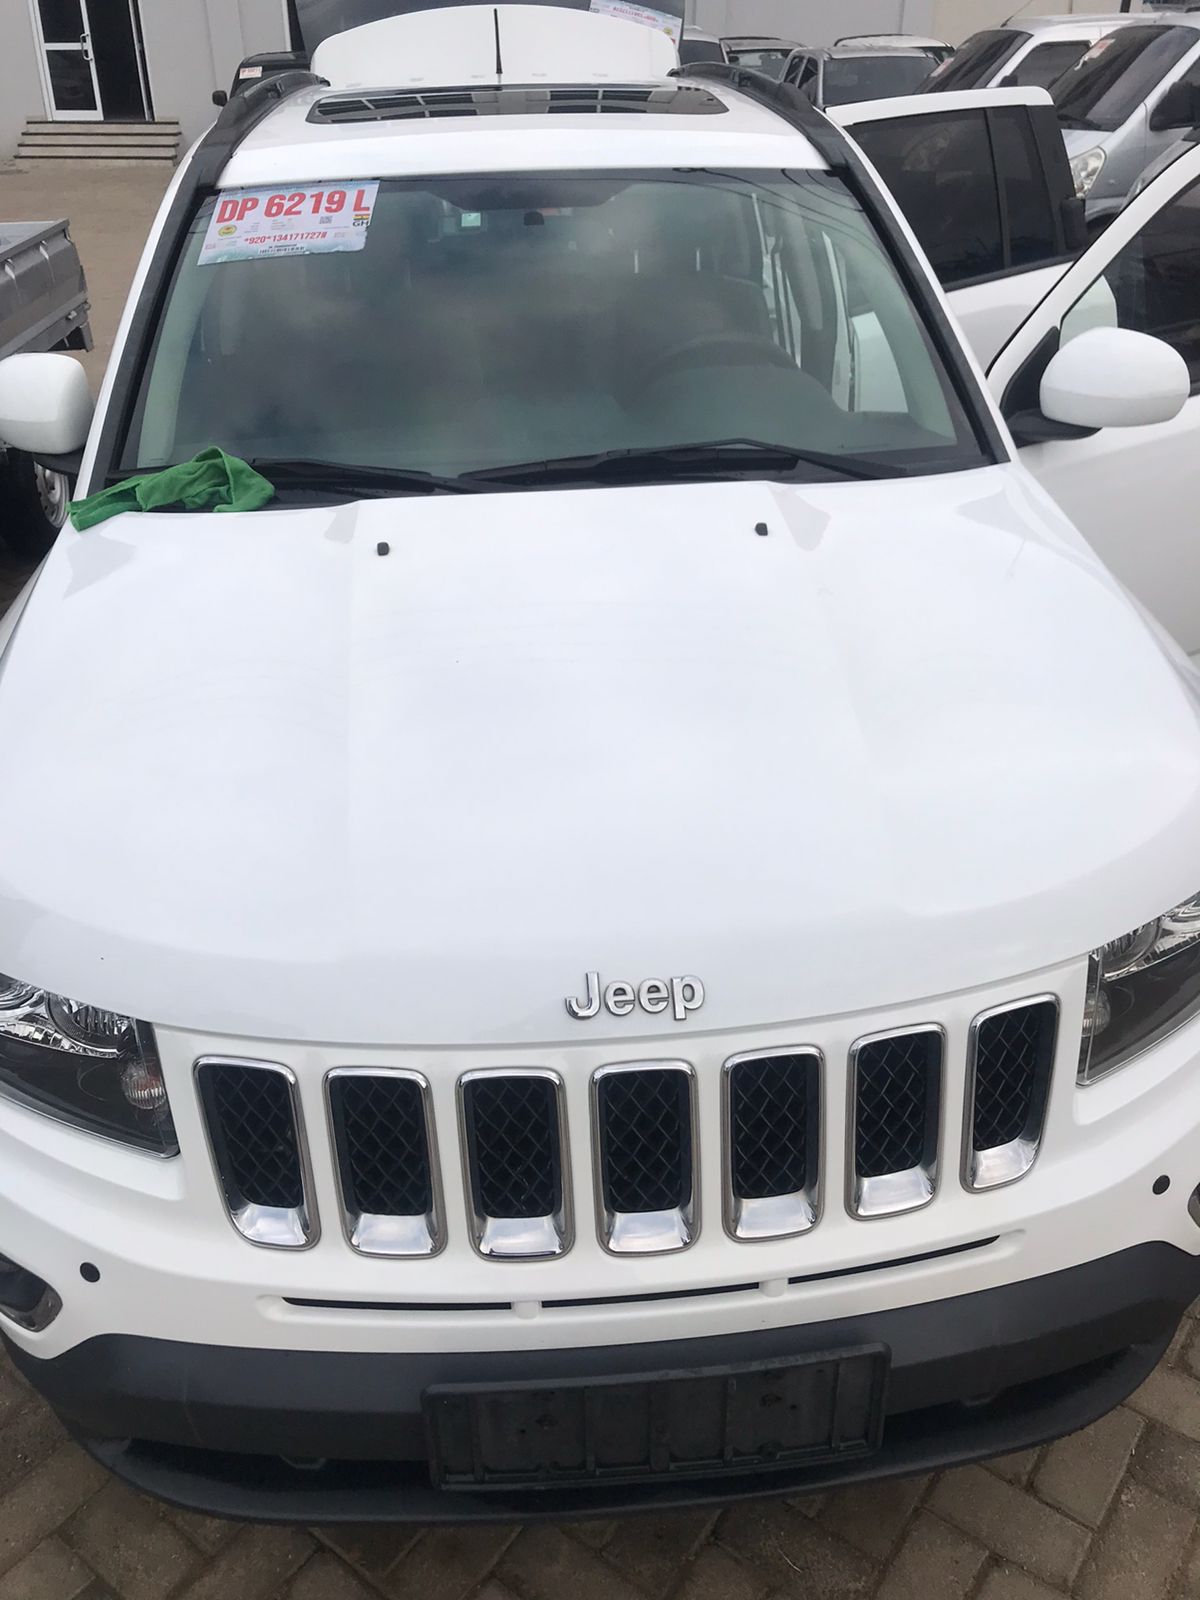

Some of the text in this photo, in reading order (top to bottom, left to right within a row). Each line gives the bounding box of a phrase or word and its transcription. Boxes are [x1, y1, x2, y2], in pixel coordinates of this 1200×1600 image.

[216, 189, 370, 223] DP 6219 L
[564, 971, 705, 1021] Jeep
